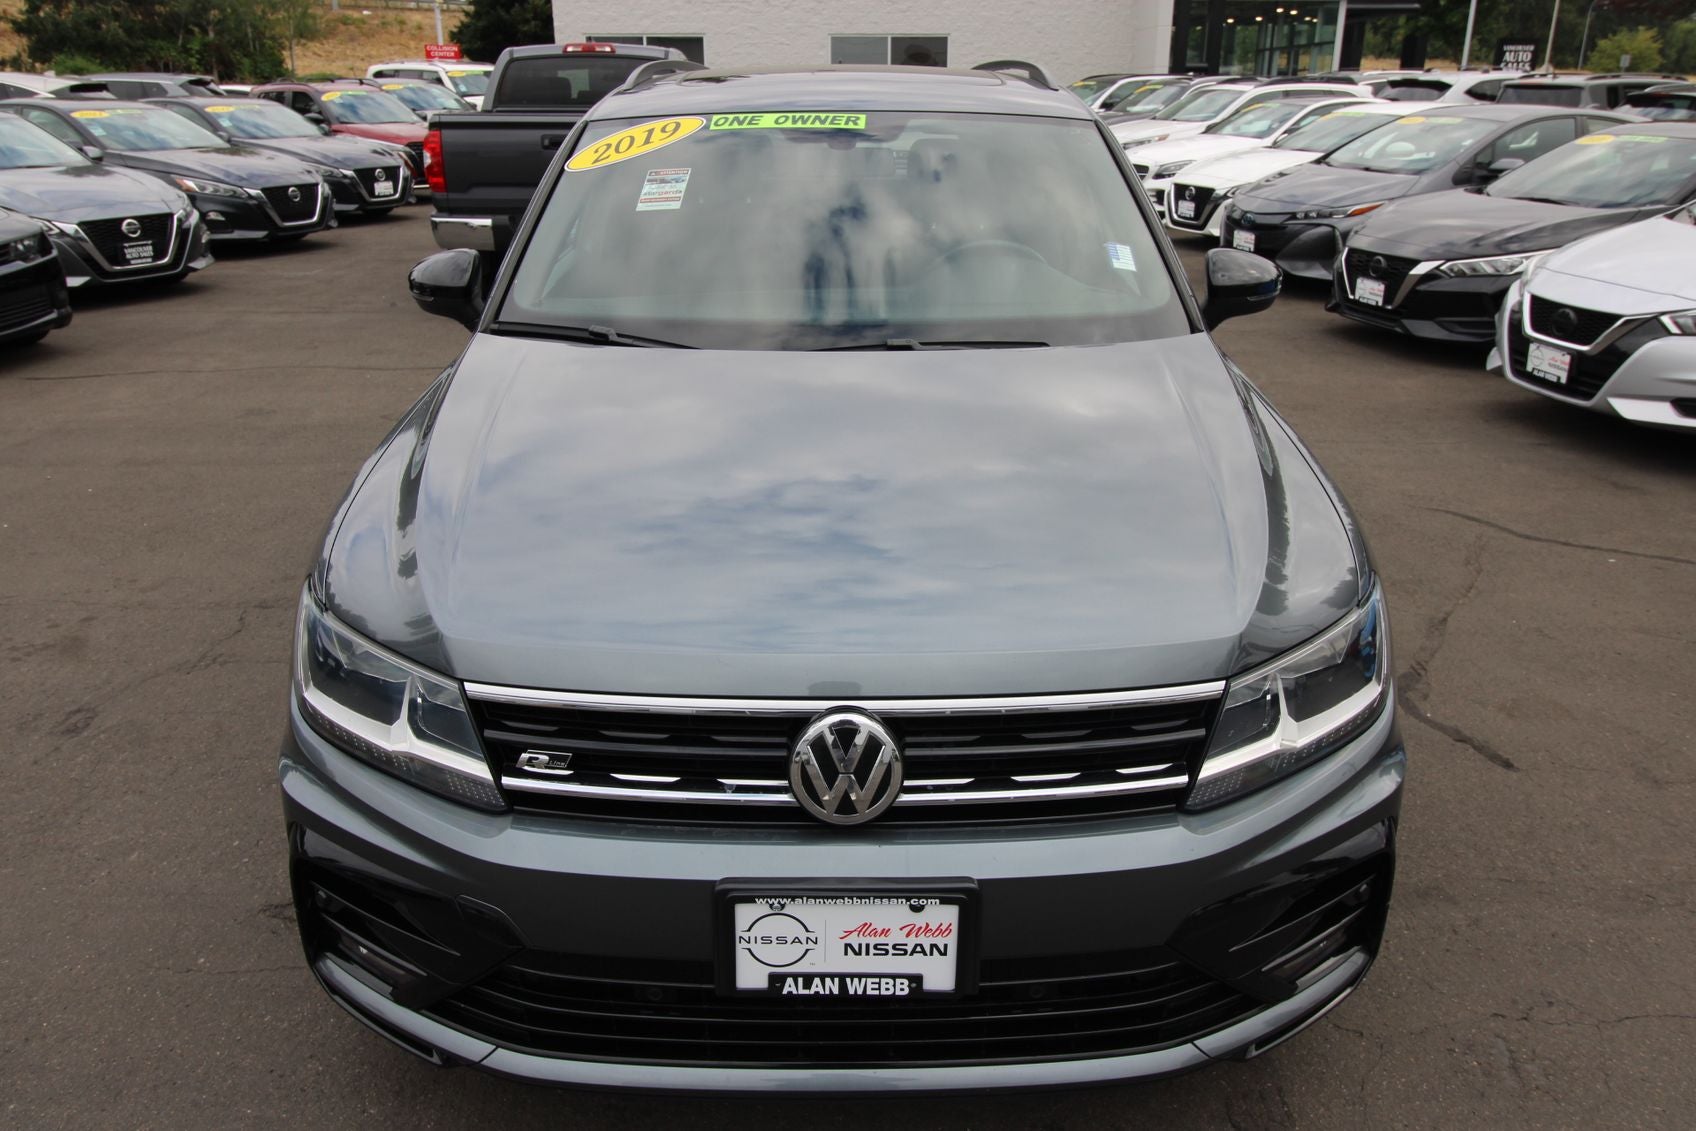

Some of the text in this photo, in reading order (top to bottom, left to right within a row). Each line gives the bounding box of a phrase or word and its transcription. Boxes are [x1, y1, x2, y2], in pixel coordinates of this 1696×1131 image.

[1502, 51, 1532, 62] AUTO
[713, 114, 861, 127] ONE OWNER
[591, 121, 682, 166] 2019
[754, 896, 940, 906] www.alanwebbnissan.com
[838, 921, 953, 940] Alan Webb
[738, 935, 818, 945] NISSAN
[843, 943, 948, 956] NISSAN
[782, 977, 909, 995] ALAN WEBB
